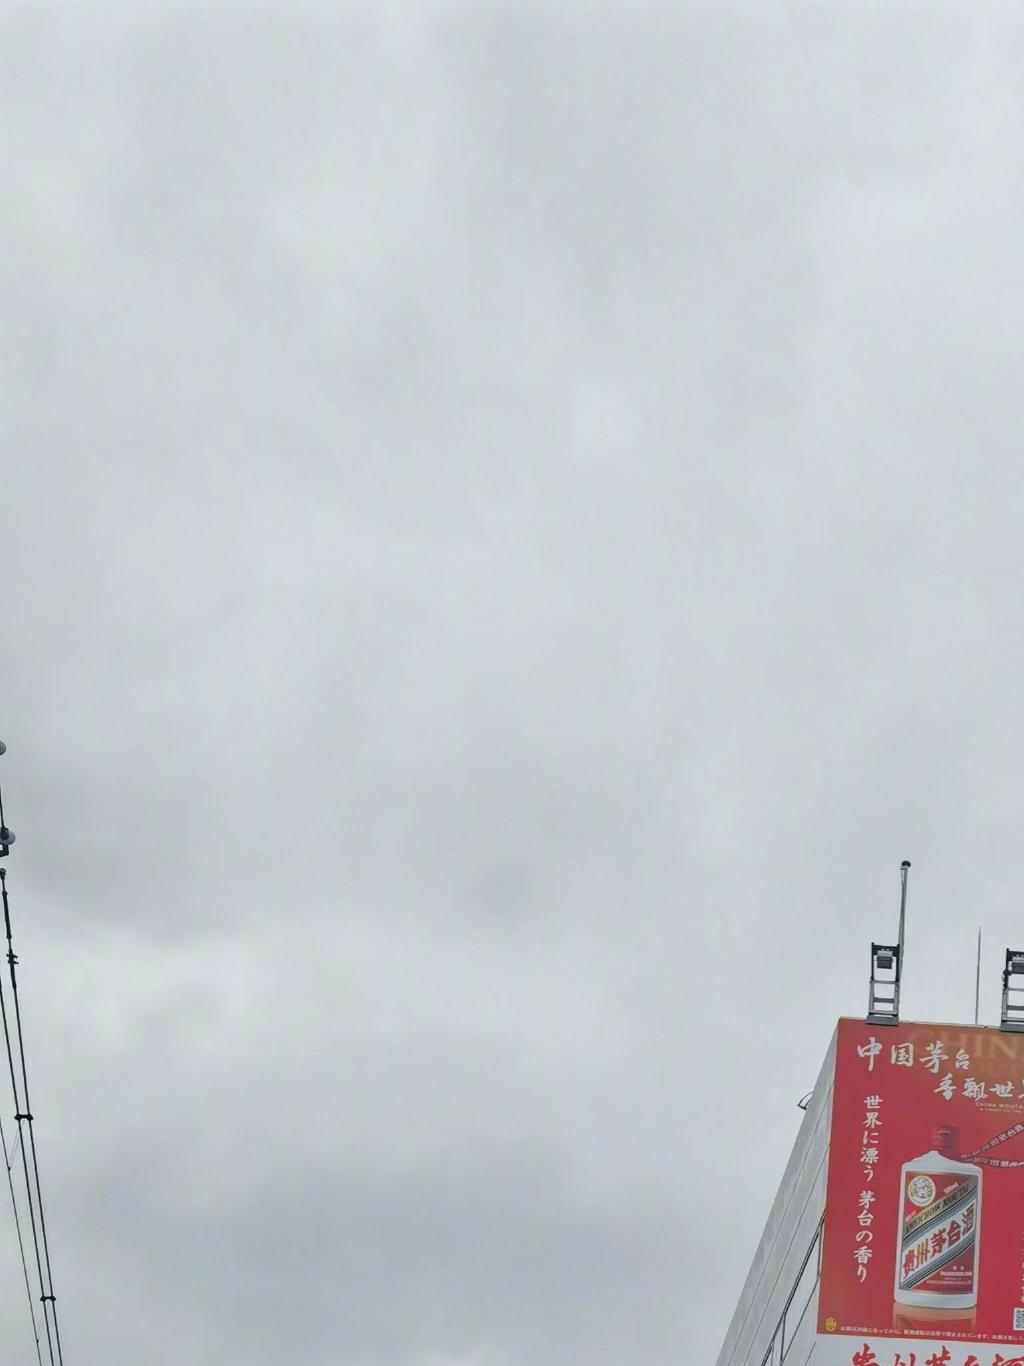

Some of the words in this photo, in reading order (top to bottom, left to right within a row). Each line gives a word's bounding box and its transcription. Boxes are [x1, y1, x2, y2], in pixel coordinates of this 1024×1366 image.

[857, 1038, 971, 1072] 中国茅台
[860, 1096, 883, 1182] 世界に漂う
[854, 1189, 876, 1283] 茅台の香り
